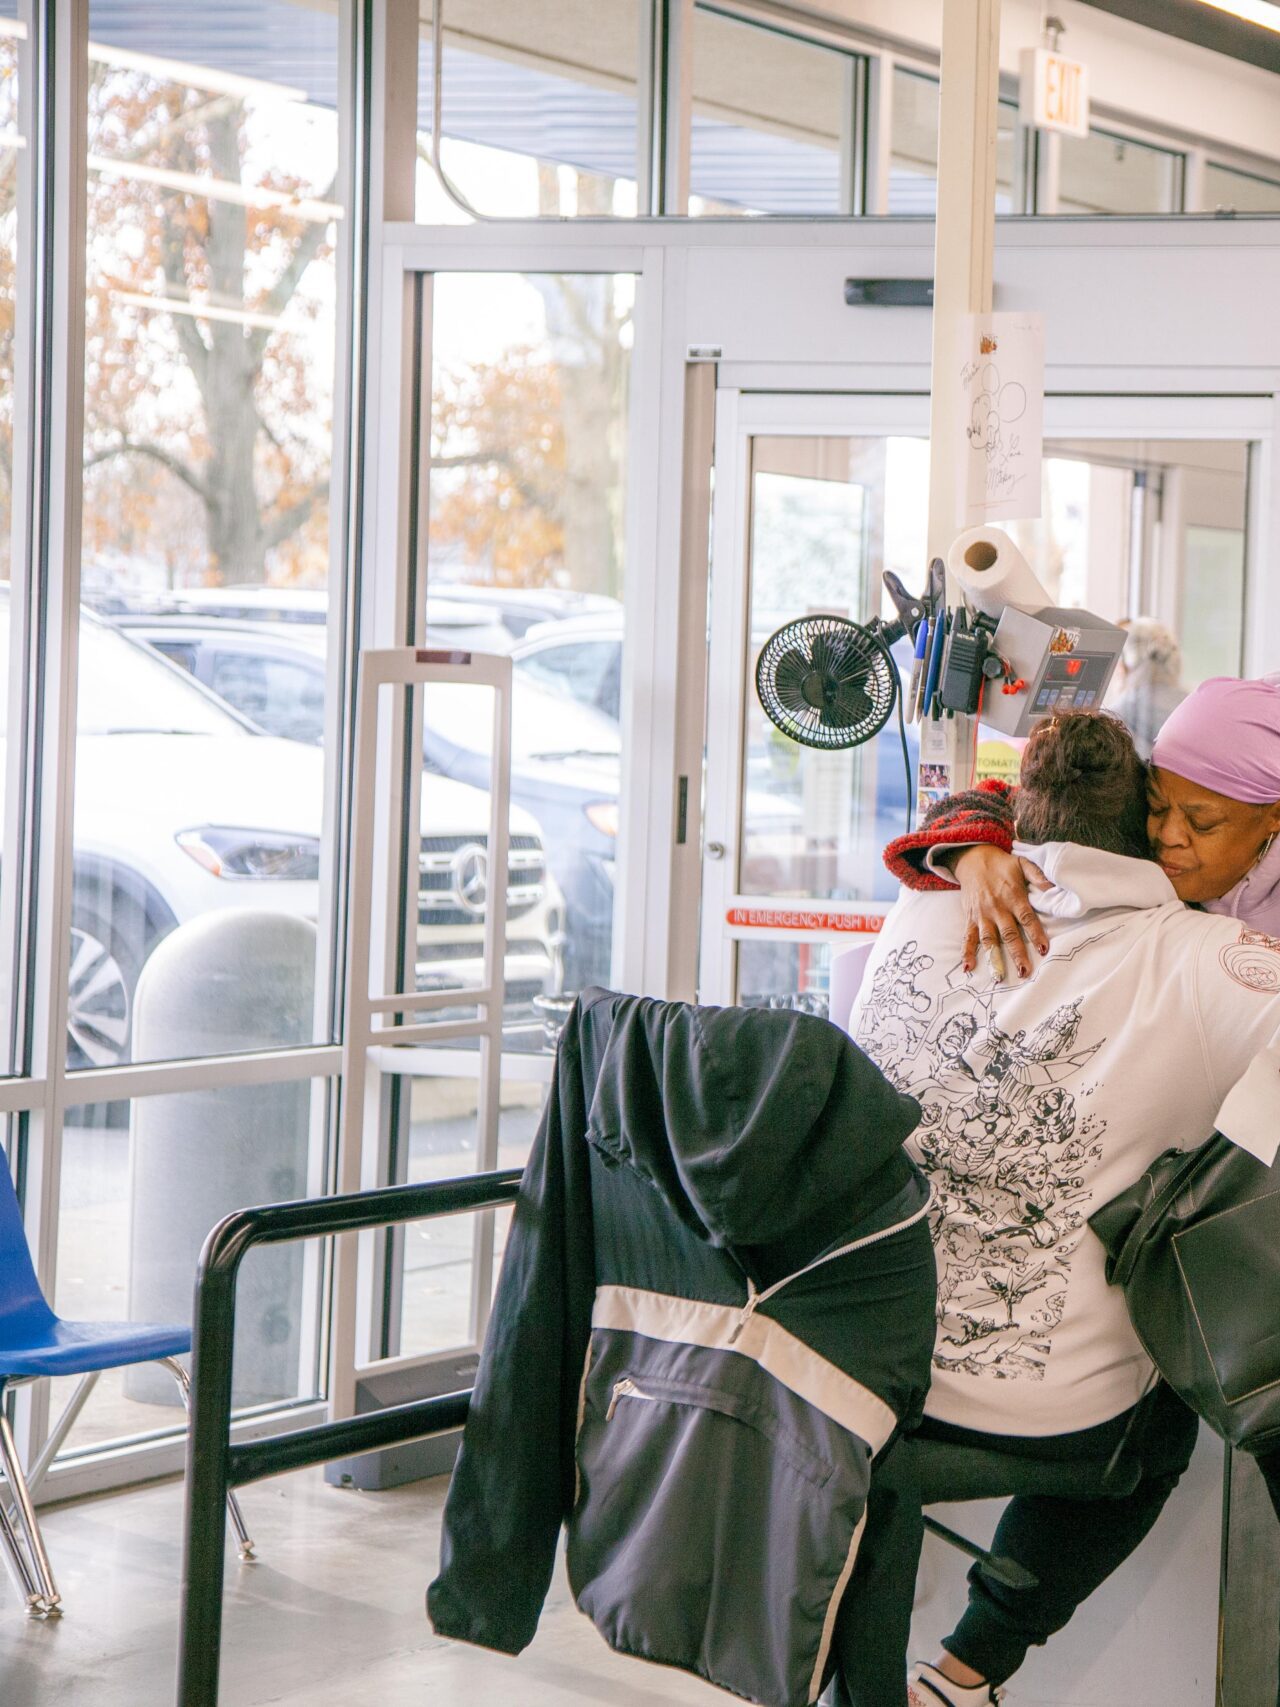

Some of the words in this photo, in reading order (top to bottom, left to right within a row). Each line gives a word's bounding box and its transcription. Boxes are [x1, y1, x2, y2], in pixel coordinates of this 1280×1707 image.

[1046, 57, 1082, 127] EXIT
[976, 757, 1020, 768] TOMATI
[733, 909, 747, 923] IN
[749, 911, 825, 929] EMERGENCY
[828, 913, 861, 930] PUSH
[865, 915, 881, 931] TO
